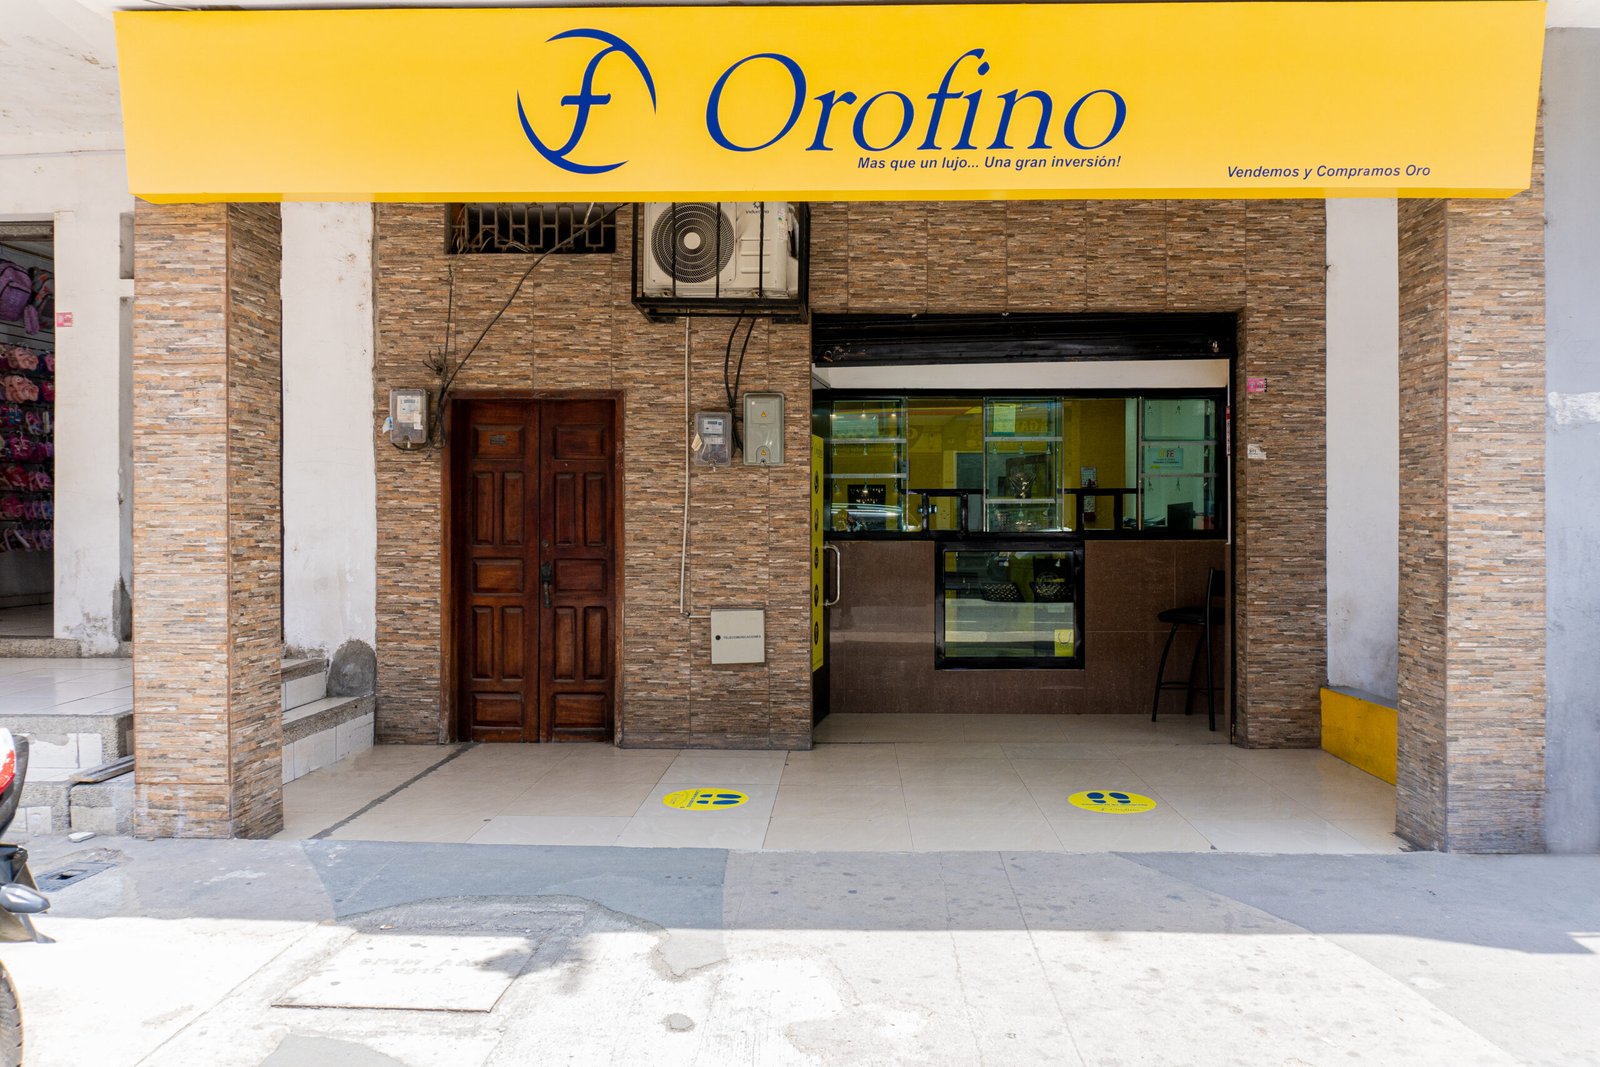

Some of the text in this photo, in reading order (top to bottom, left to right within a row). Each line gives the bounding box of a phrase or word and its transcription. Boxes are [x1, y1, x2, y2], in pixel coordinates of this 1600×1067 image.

[706, 48, 1127, 153] Orofino
[857, 155, 1121, 172] Mas que un lujo... Una gran inversión!
[1227, 164, 1431, 181] Vendemos y Compramos Oro
